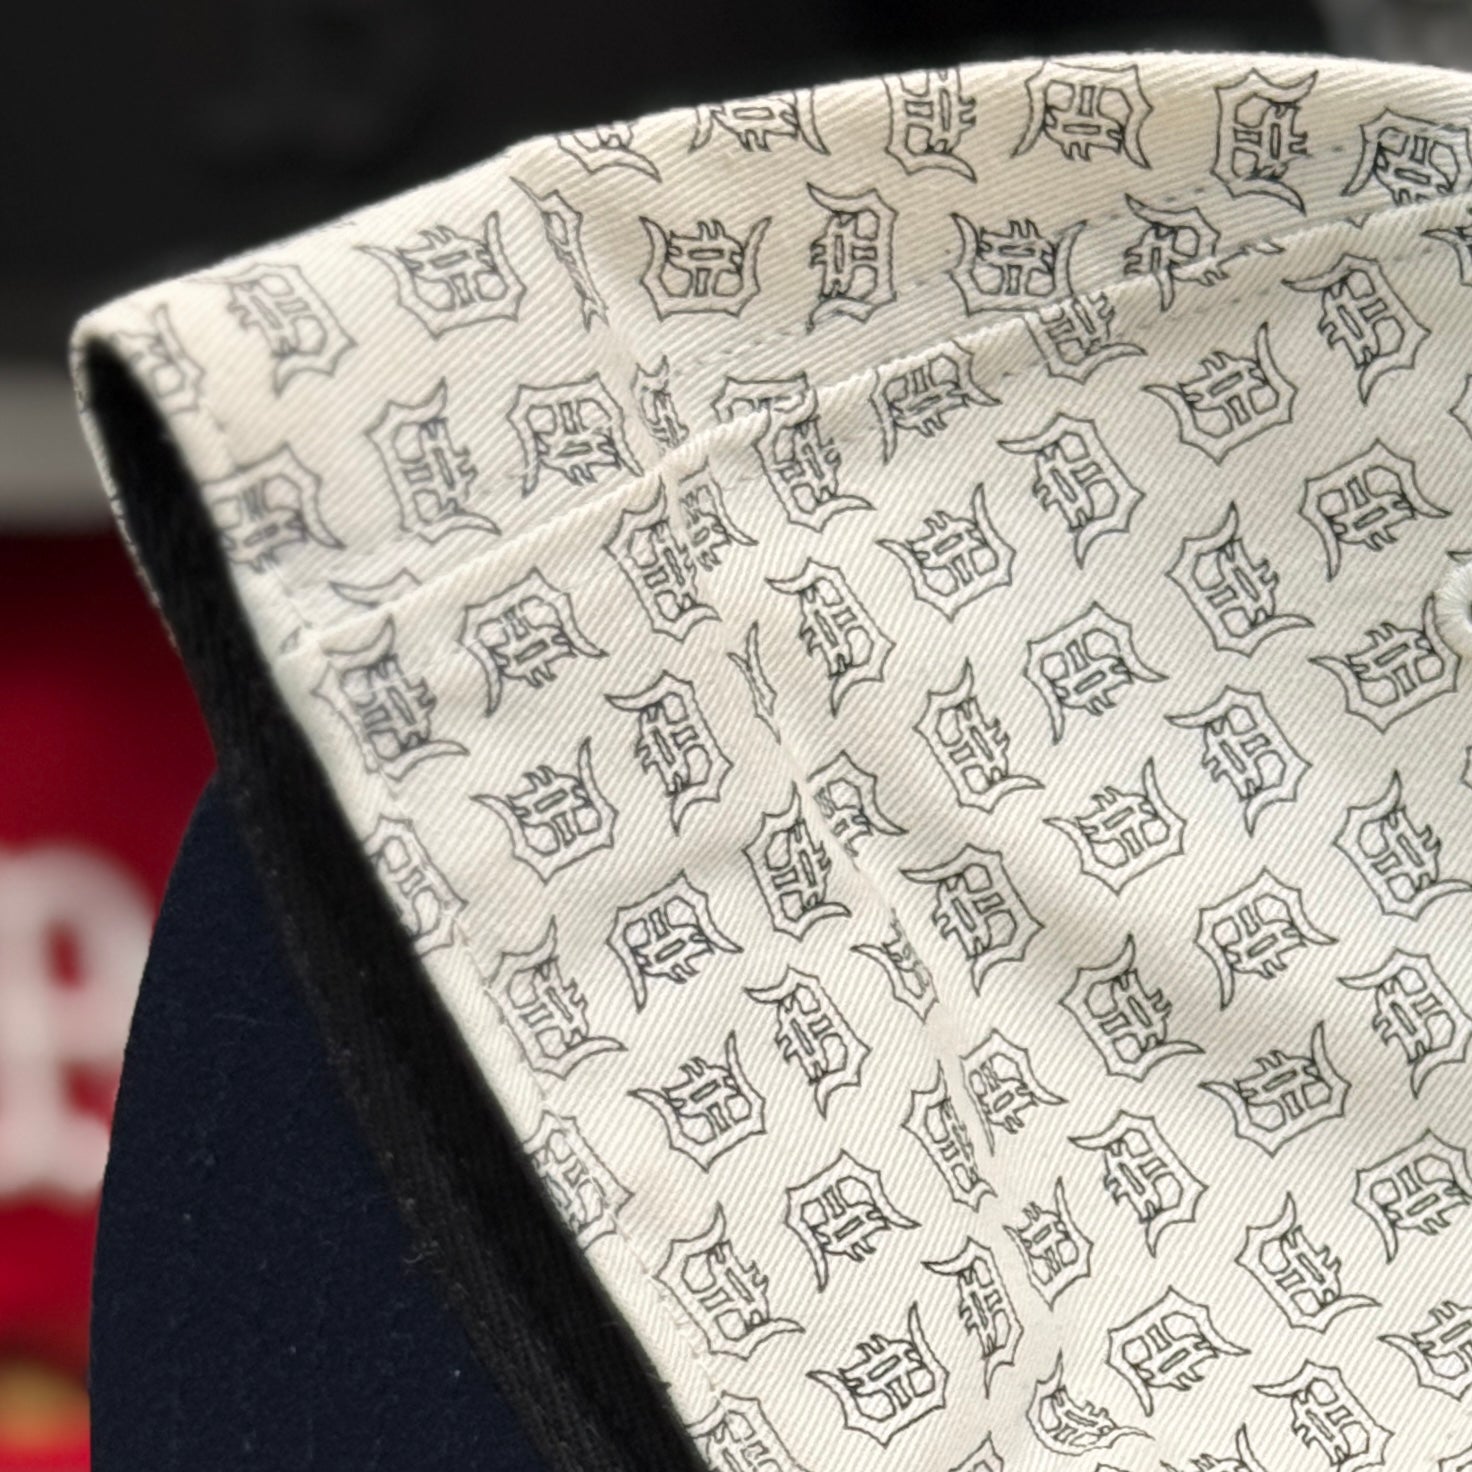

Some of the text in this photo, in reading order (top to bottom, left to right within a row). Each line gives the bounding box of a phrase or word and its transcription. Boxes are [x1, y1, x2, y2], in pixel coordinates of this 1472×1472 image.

[1009, 65, 1155, 171] D
[1209, 68, 1318, 216] D
[352, 210, 528, 342] D
[637, 215, 773, 323] D
[805, 181, 899, 336] D
[1280, 251, 1432, 407] D
[362, 376, 503, 547] D
[505, 371, 644, 499] D
[868, 341, 1003, 466] D
[1139, 320, 1300, 467] D
[602, 476, 722, 642] D
[873, 481, 1017, 624] D
[996, 410, 1147, 570] D
[1296, 437, 1453, 583] D
[455, 565, 610, 719] D
[764, 556, 897, 719] D
[1163, 499, 1316, 659] D
[912, 656, 1046, 815] D
[1020, 600, 1170, 746] D
[1306, 589, 1464, 735] D
[468, 736, 620, 887] D
[603, 669, 735, 837] D
[1041, 755, 1188, 897] D
[1163, 684, 1313, 839] D
[742, 780, 852, 942] D
[897, 842, 1046, 998] D
[482, 914, 628, 1081] D
[603, 868, 745, 1015] D
[1056, 931, 1206, 1083] D
[1192, 865, 1340, 1012] D
[625, 1029, 768, 1174] D
[741, 964, 873, 1121] D
[1196, 1019, 1353, 1159] D
[781, 1148, 922, 1294] D
[1002, 1175, 1095, 1313] D
[1067, 1108, 1210, 1259] D
[652, 1200, 806, 1363] D
[919, 1235, 1025, 1400] D
[1233, 1191, 1383, 1336] D
[805, 1300, 951, 1450] D
[1103, 1284, 1252, 1418] D
